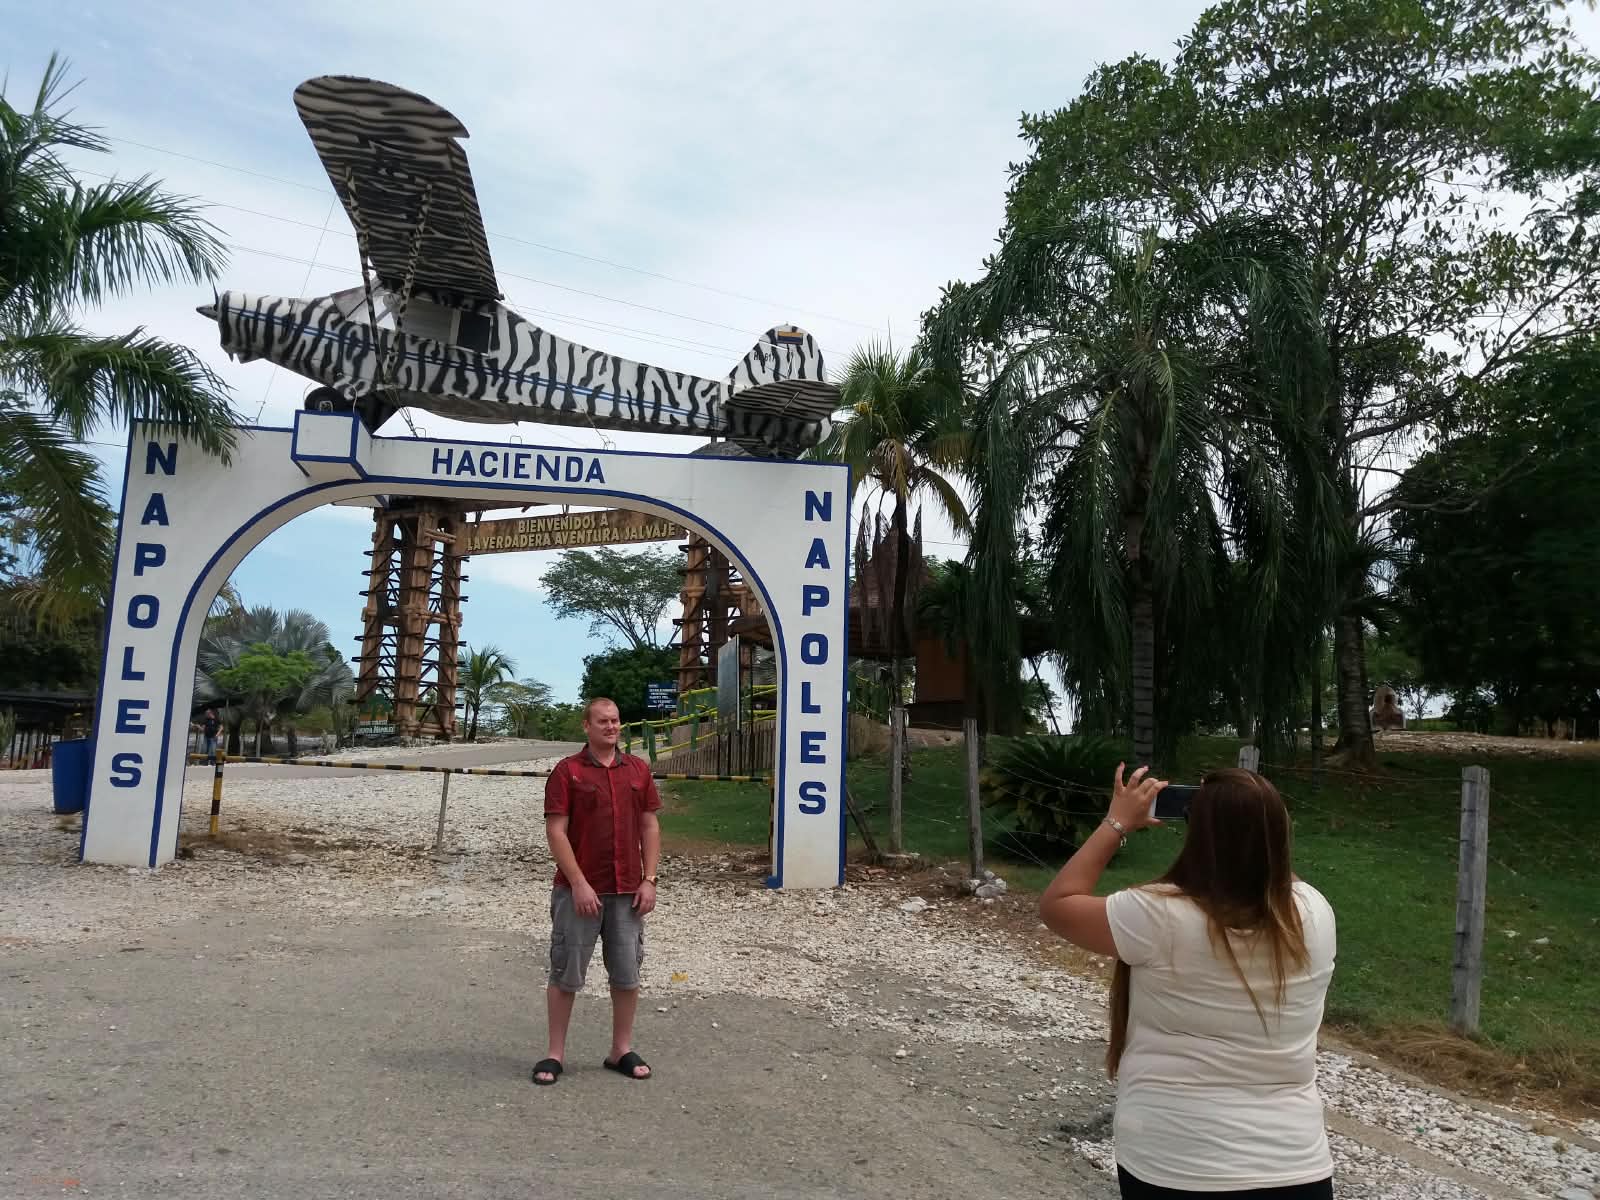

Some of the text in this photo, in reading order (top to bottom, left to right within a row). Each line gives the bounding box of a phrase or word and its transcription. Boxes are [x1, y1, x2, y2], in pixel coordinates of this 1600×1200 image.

[432, 448, 606, 484] HACIENDA
[467, 522, 676, 551] LA VERDADERA AVENTURA SALVAJE
[518, 512, 609, 534] BIENVENIDOS A
[109, 441, 178, 788] NAPOLES
[798, 490, 832, 815] NAPOLES
